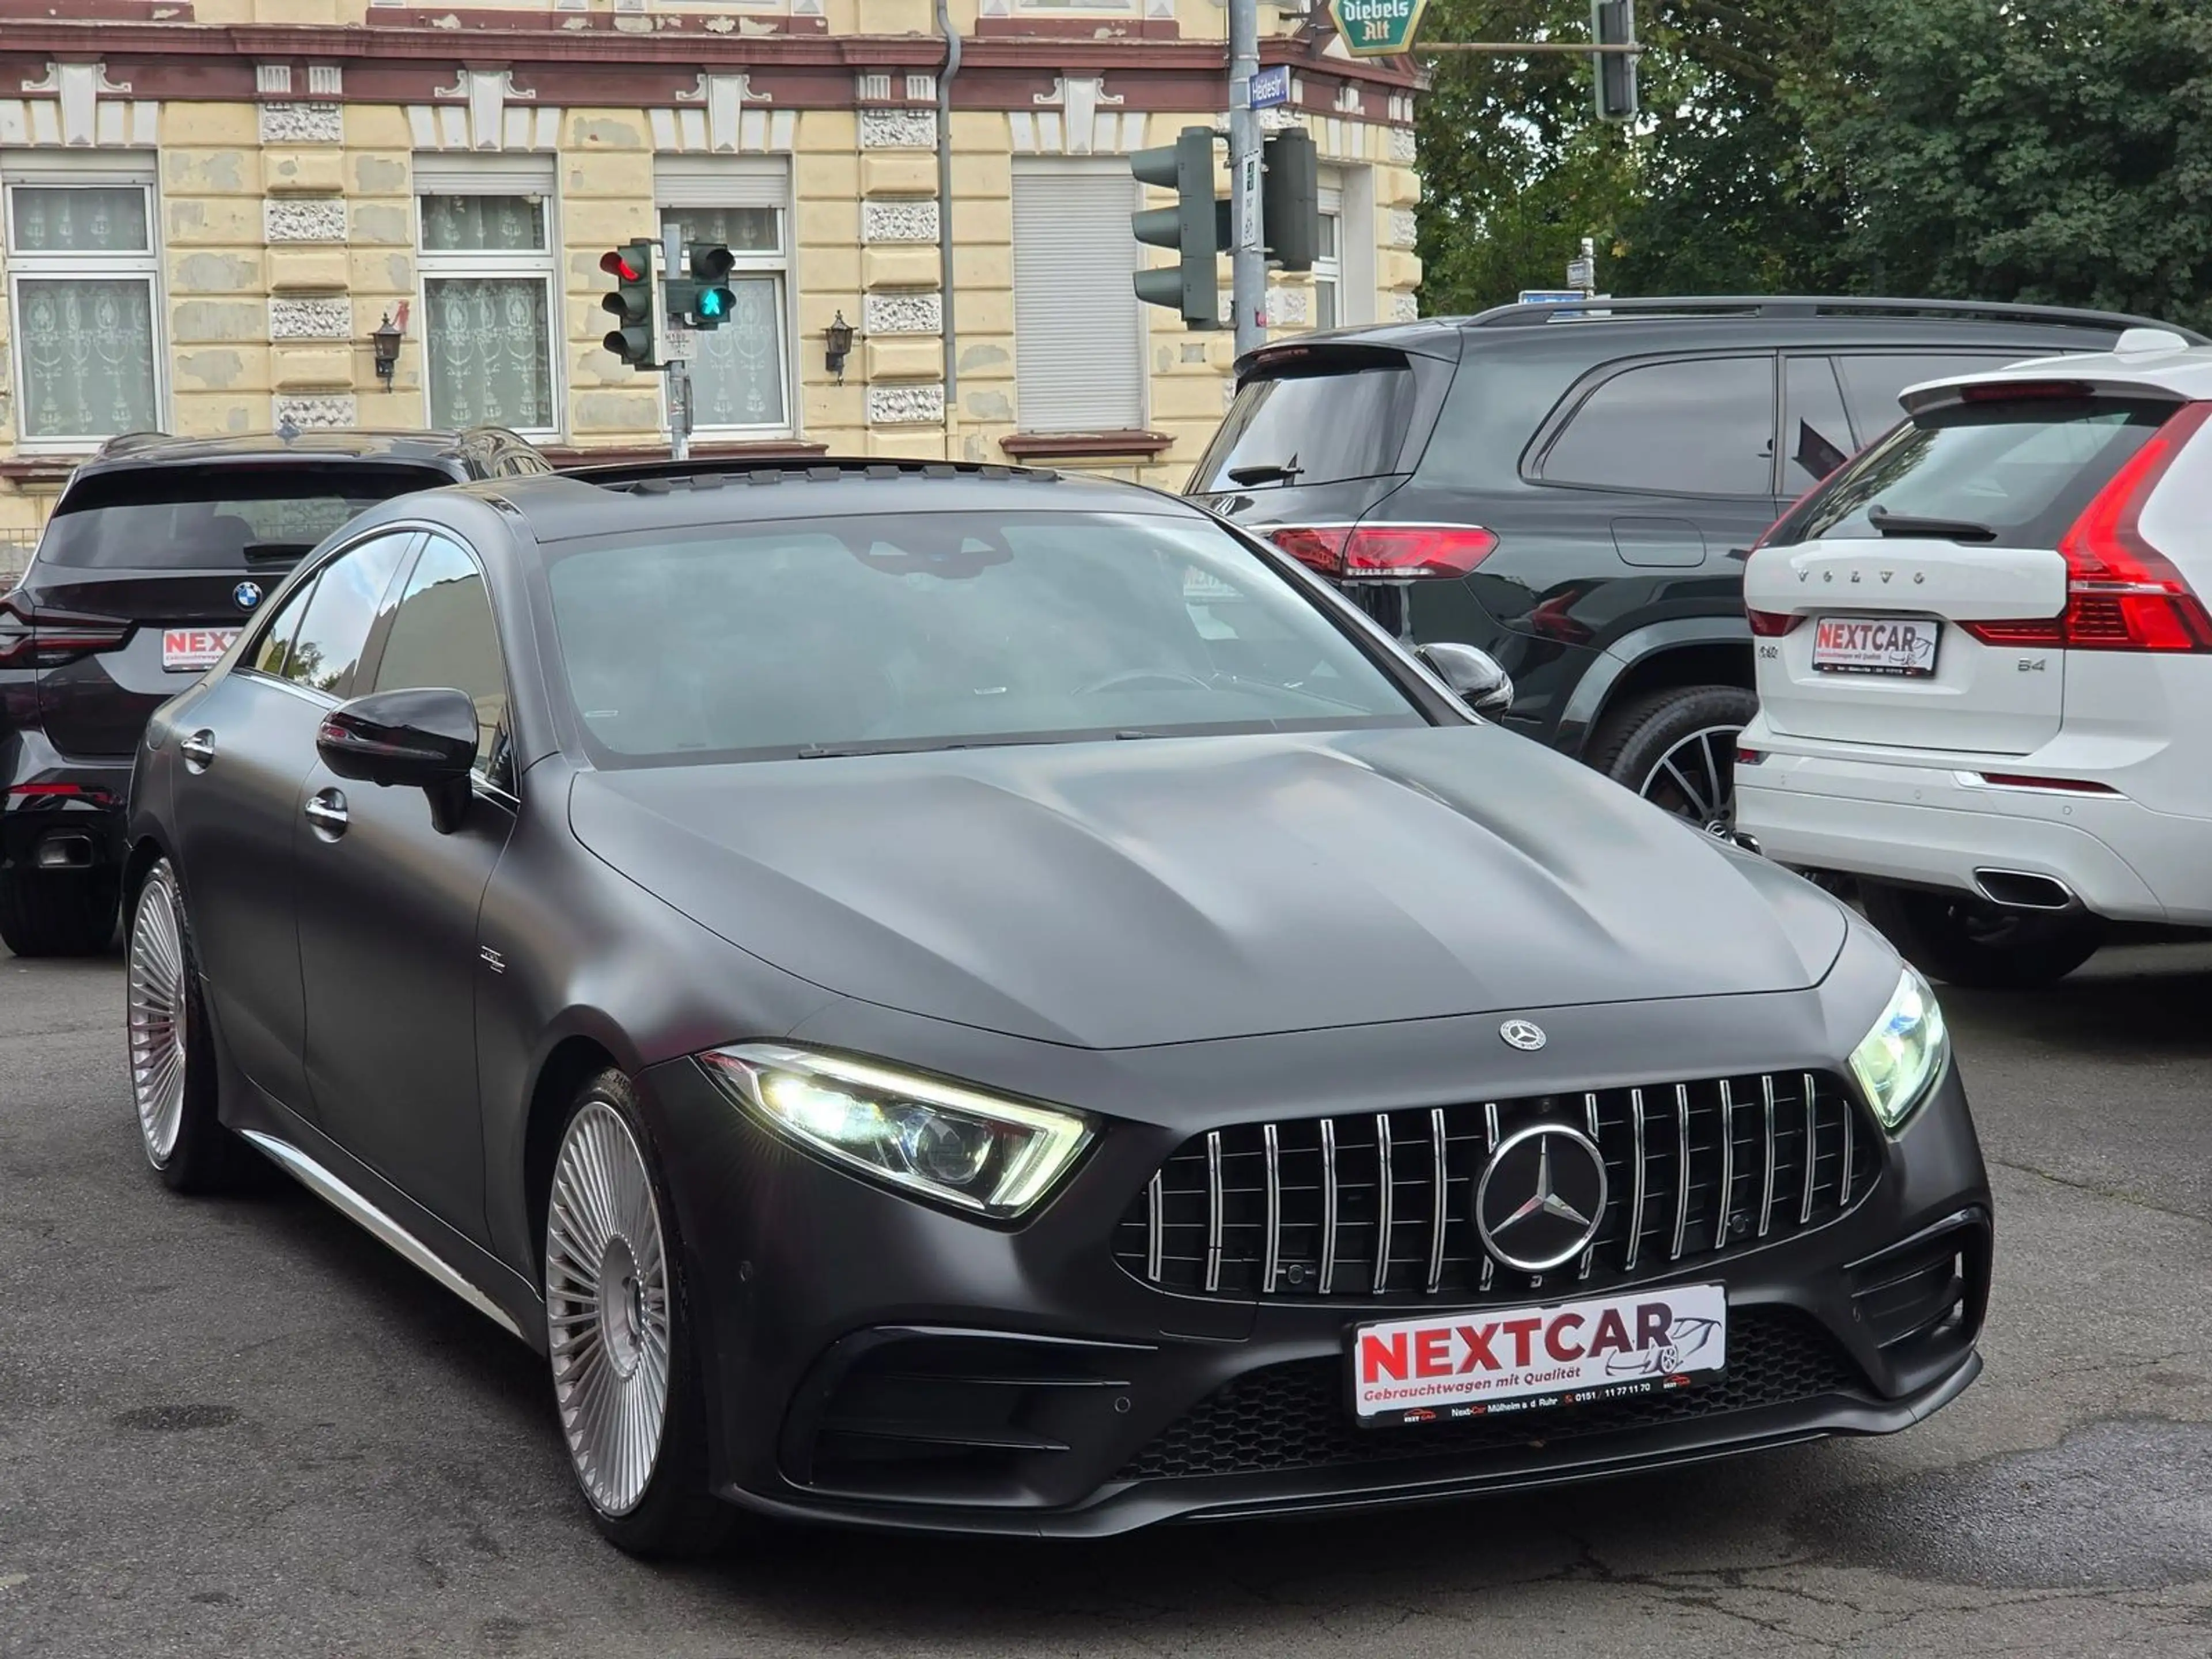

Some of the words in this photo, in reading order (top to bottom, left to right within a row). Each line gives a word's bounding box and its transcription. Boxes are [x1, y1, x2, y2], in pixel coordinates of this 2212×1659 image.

[1362, 21, 1391, 41] Alt
[1818, 623, 1916, 652] NEXTCAR
[2018, 657, 2046, 672] B4
[1362, 1302, 1673, 1384] NEXTCAR
[1363, 1380, 1492, 1402] Gebrauchtwagen
[1495, 1373, 1520, 1387] mit
[1524, 1366, 1581, 1385] Qualität
